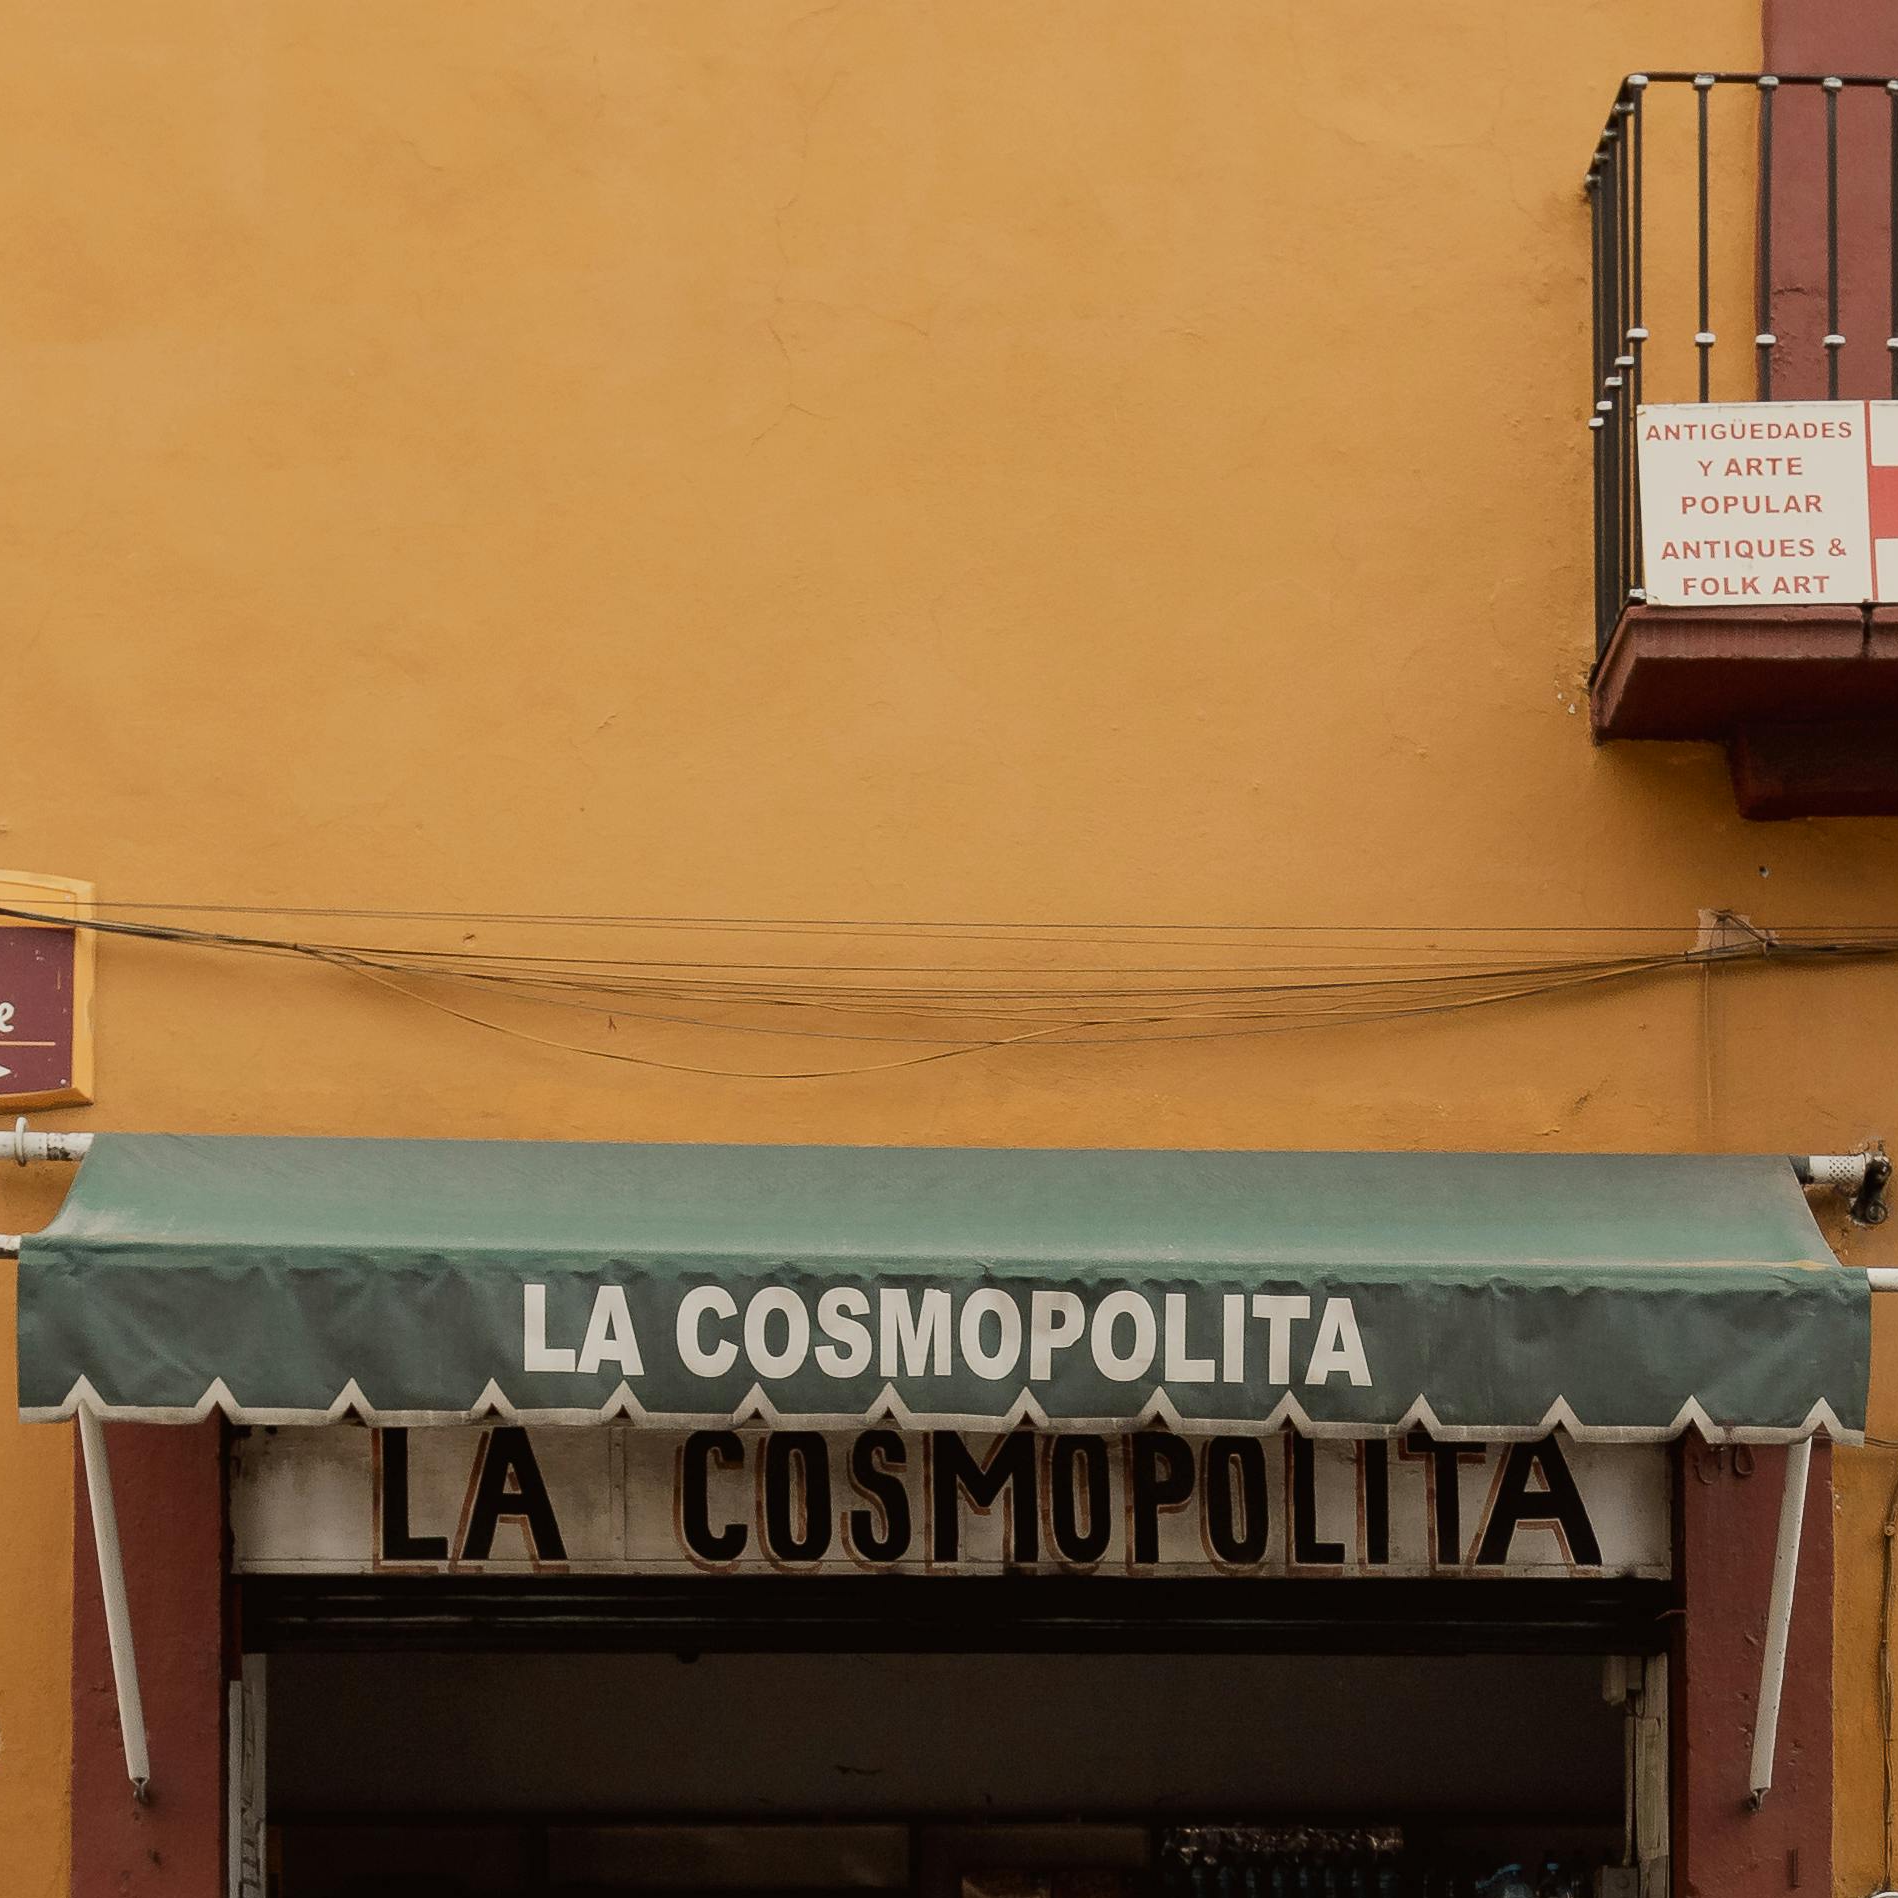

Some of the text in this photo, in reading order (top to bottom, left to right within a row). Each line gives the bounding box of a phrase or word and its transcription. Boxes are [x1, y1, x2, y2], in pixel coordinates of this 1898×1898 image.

[1645, 419, 1853, 441] ANTIGÜEDADES
[1698, 457, 1803, 476] Y ARTE
[1681, 494, 1823, 514] POPULAR
[1661, 538, 1847, 561] ANTIQUES &
[1682, 575, 1831, 596] FOLK ART
[523, 1283, 1373, 1387] LA COSMOPOLITA
[374, 1427, 1602, 1571] LA COSMOPOLITA
